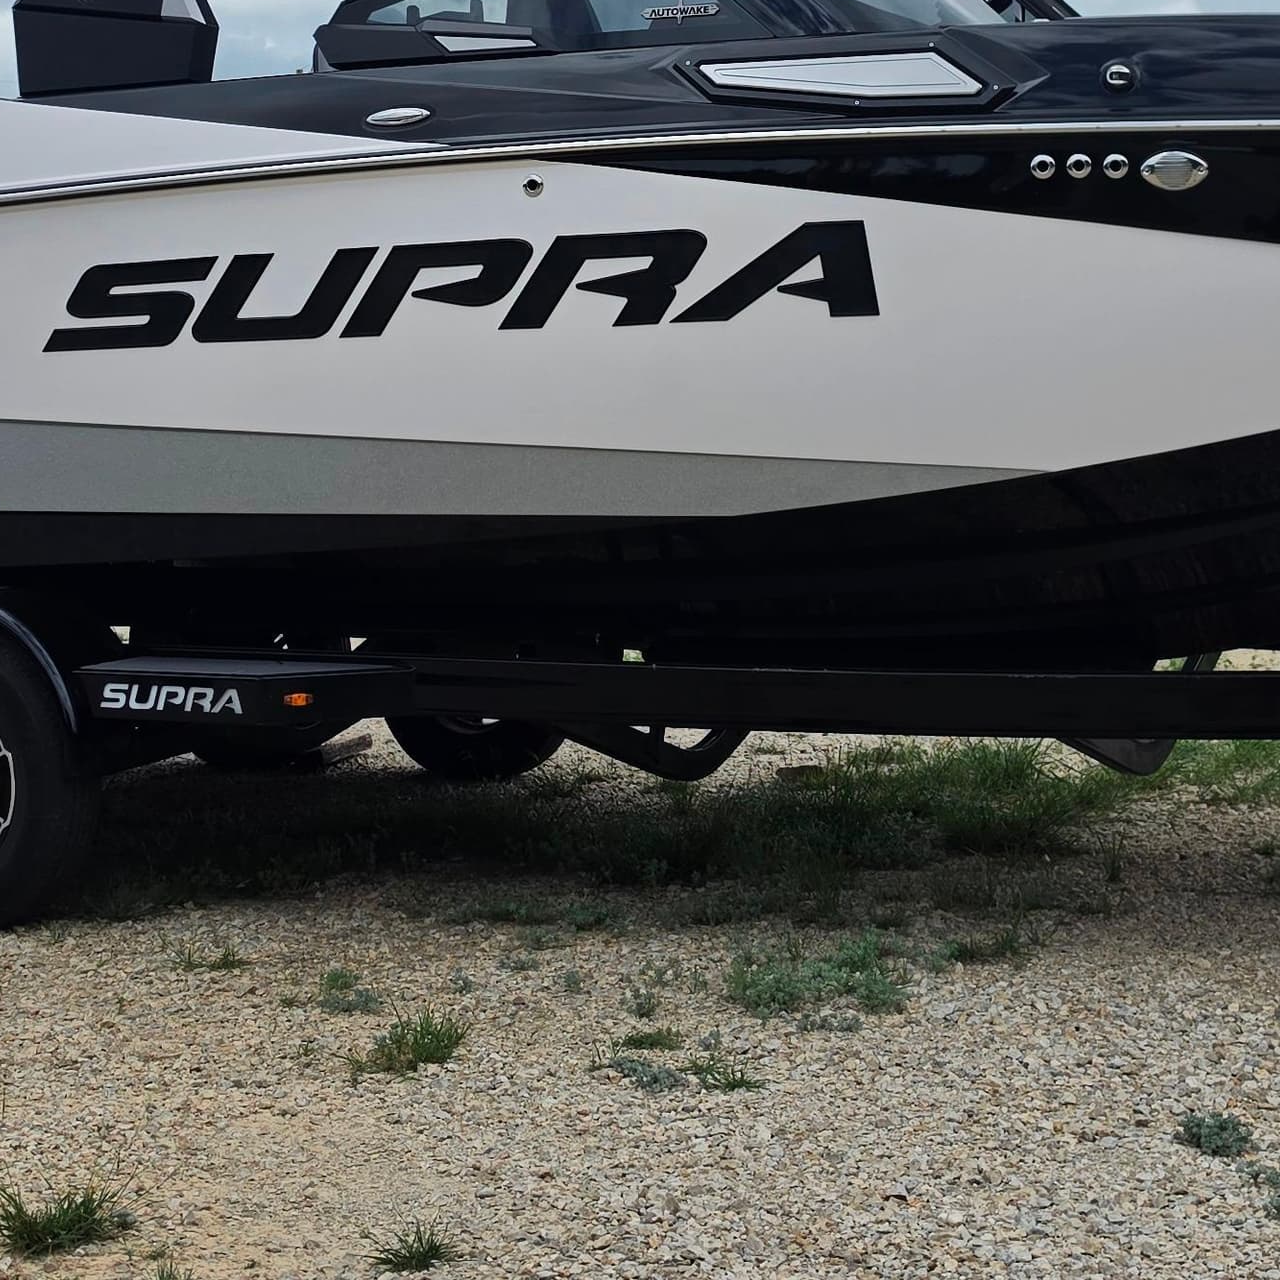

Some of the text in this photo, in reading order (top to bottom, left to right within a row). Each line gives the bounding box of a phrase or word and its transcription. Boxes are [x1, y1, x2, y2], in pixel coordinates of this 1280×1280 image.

[649, 6, 710, 17] AUTOWAKE
[42, 220, 881, 353] SUPRA
[100, 683, 244, 715] SUPRA
